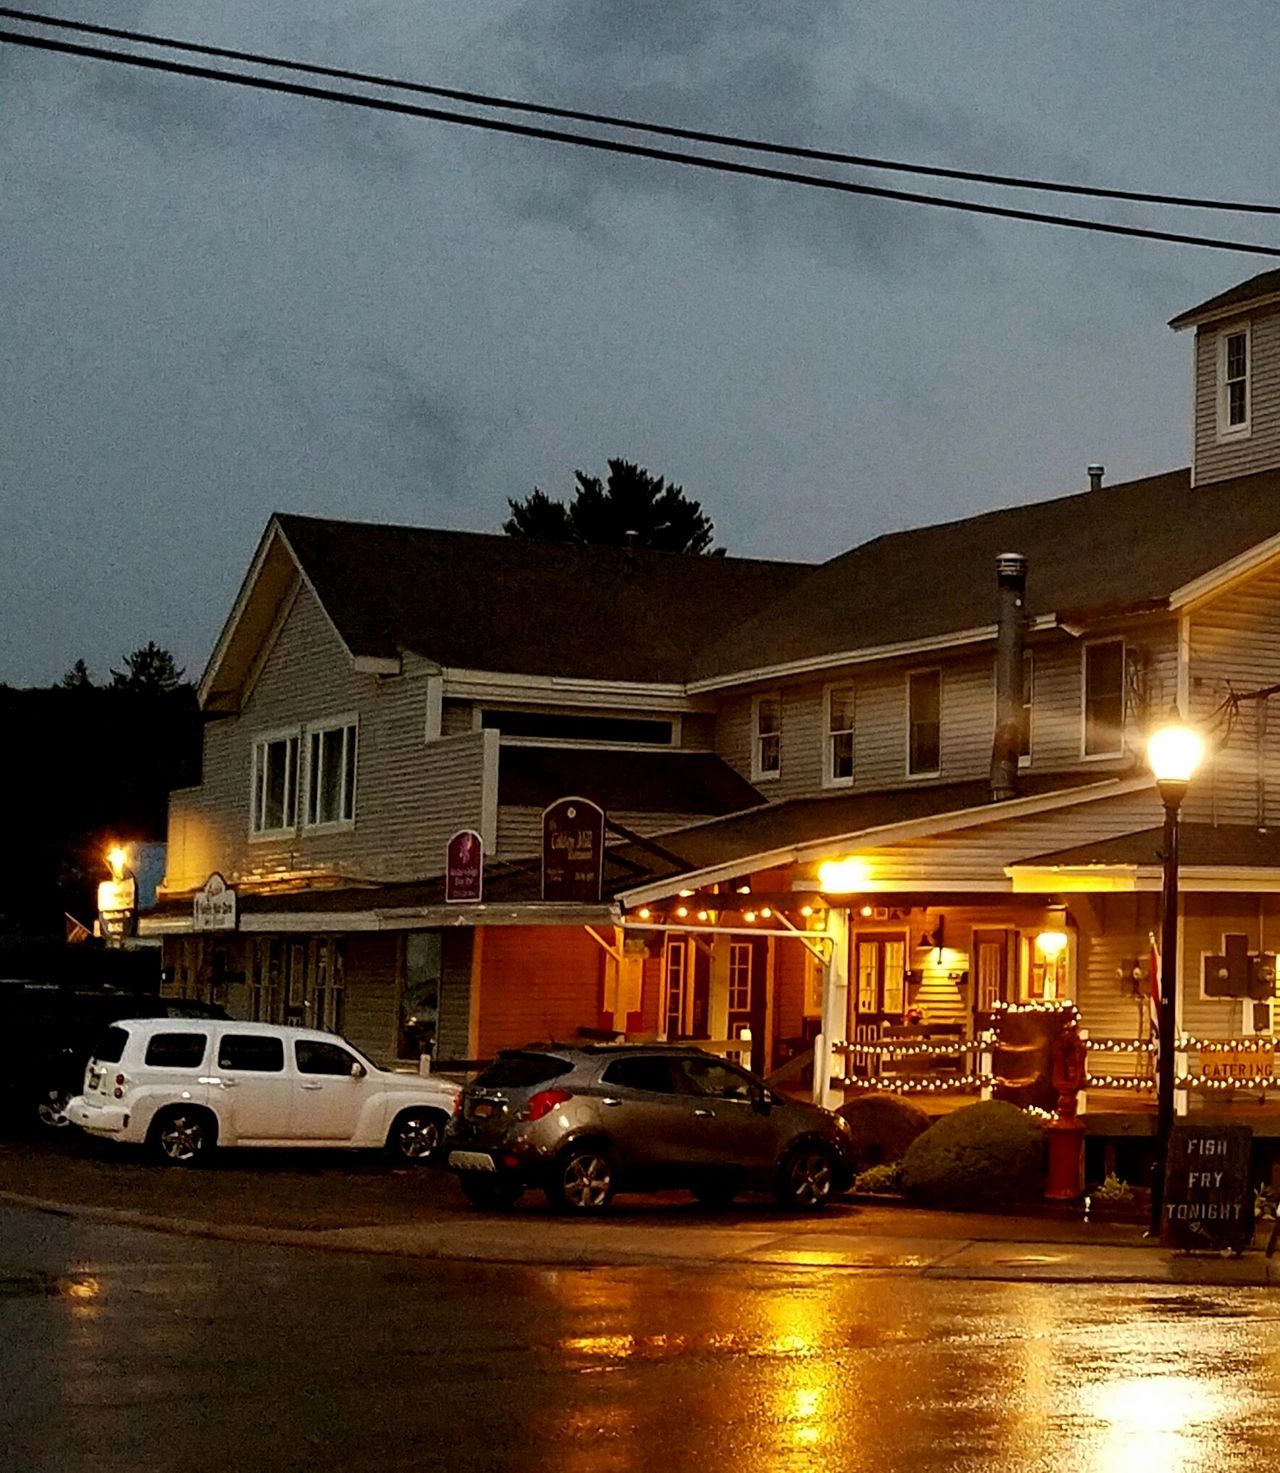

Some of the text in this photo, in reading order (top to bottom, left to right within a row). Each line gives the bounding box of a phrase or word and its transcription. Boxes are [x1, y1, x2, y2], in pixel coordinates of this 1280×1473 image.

[1202, 1063, 1274, 1077] CATERING
[1187, 1138, 1228, 1157] FISH
[1187, 1171, 1224, 1189] FRY
[1165, 1203, 1243, 1221] TONIGHT
